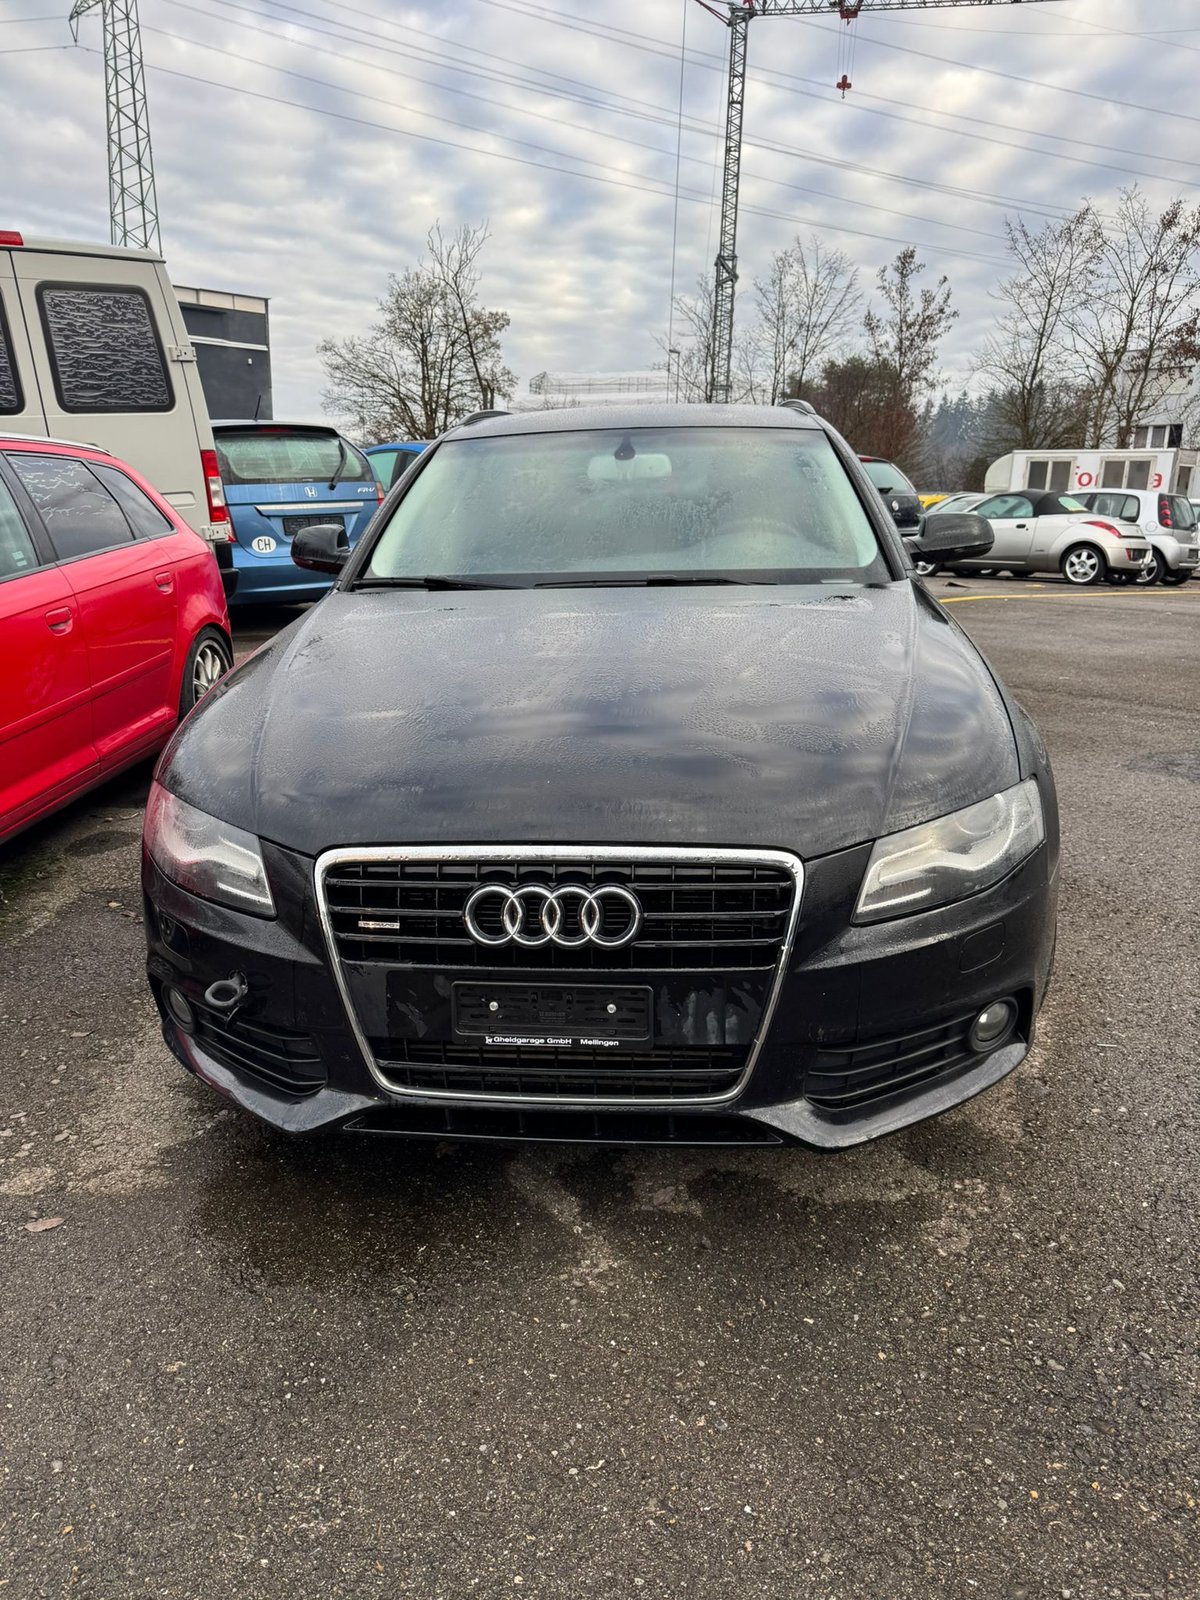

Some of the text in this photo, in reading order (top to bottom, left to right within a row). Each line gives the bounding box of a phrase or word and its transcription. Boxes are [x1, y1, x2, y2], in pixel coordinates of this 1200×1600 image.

[257, 538, 272, 551] CH
[493, 1036, 619, 1047] Gheidgarage GmbH Mellingen
